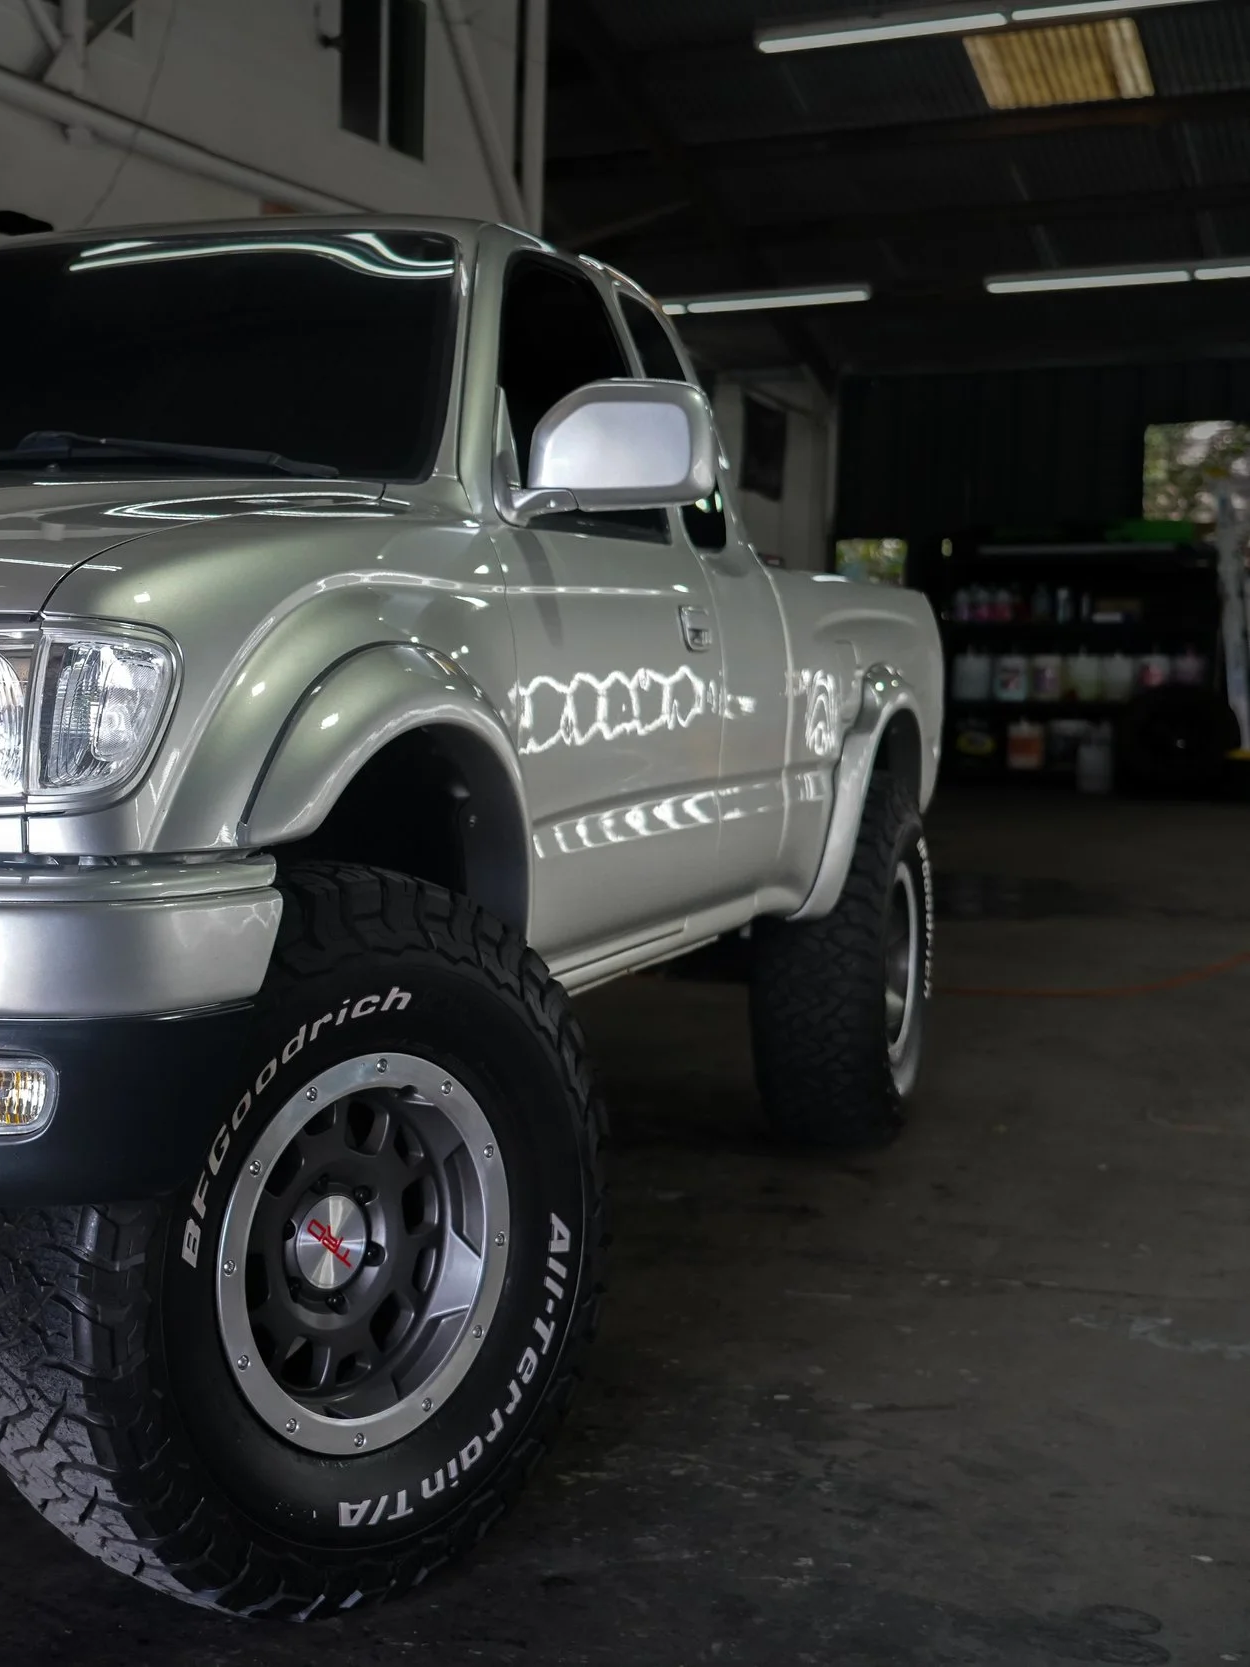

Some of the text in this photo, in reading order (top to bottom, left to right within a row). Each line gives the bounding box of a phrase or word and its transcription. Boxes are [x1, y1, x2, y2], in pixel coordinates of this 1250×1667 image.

[181, 986, 412, 1269] BFGoodrich
[307, 1219, 354, 1269] TRD
[338, 1211, 571, 1527] All-Terrain T/A
